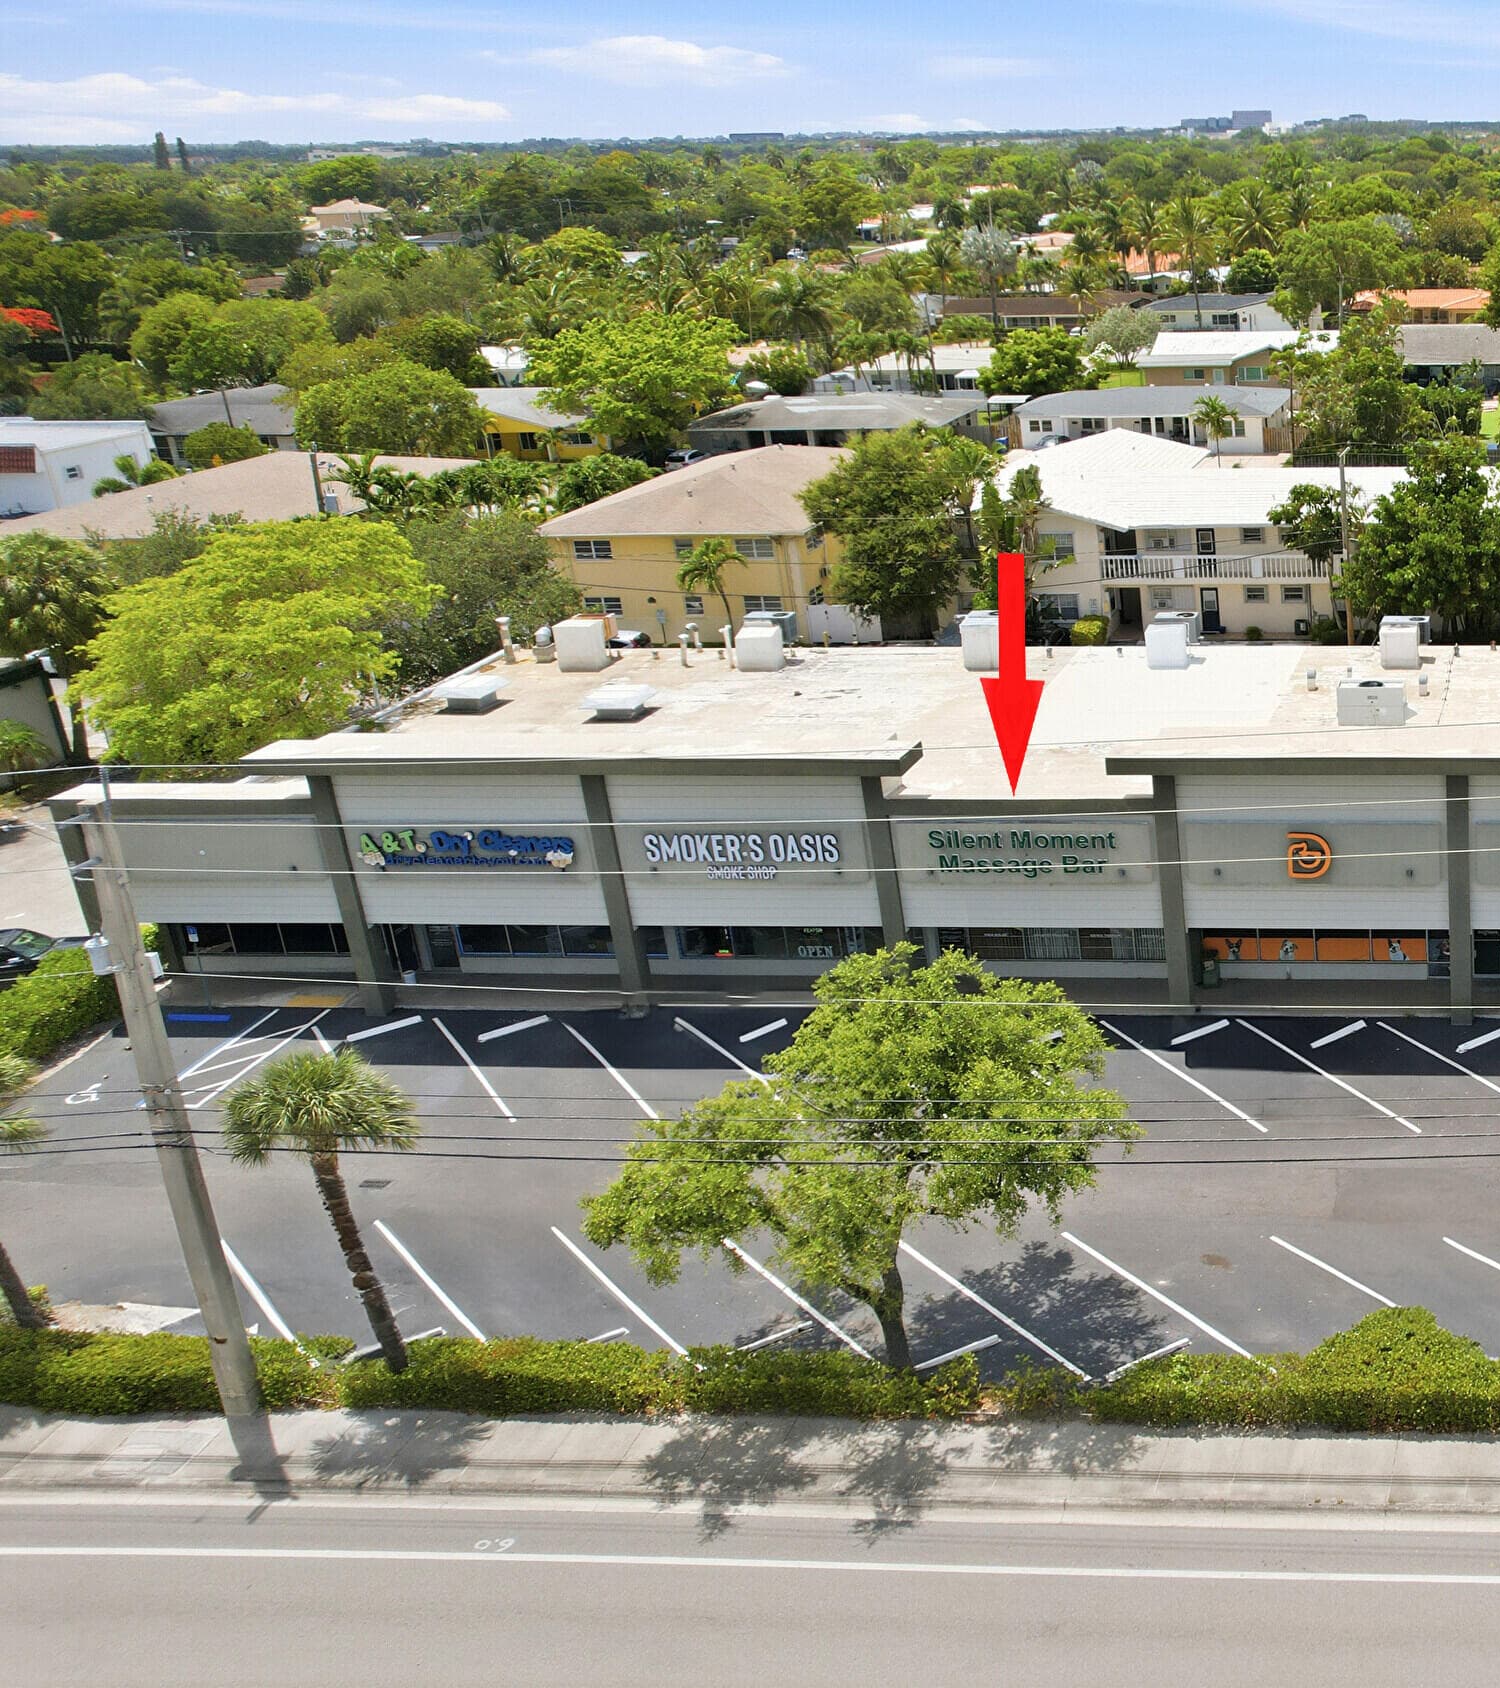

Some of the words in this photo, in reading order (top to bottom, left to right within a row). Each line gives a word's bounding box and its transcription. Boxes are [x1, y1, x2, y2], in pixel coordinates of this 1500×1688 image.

[430, 830, 471, 856] Dry
[478, 829, 574, 854] Cleaners
[643, 833, 764, 863] SMOKER'S
[768, 833, 840, 863] OASIS
[928, 830, 1002, 849] Silent
[1010, 830, 1117, 849] Moment
[706, 865, 746, 880] SMOKE
[747, 865, 777, 880] SHOP
[938, 854, 1053, 878] Massage
[1061, 855, 1107, 874] Bar
[797, 945, 833, 958] OPEN
